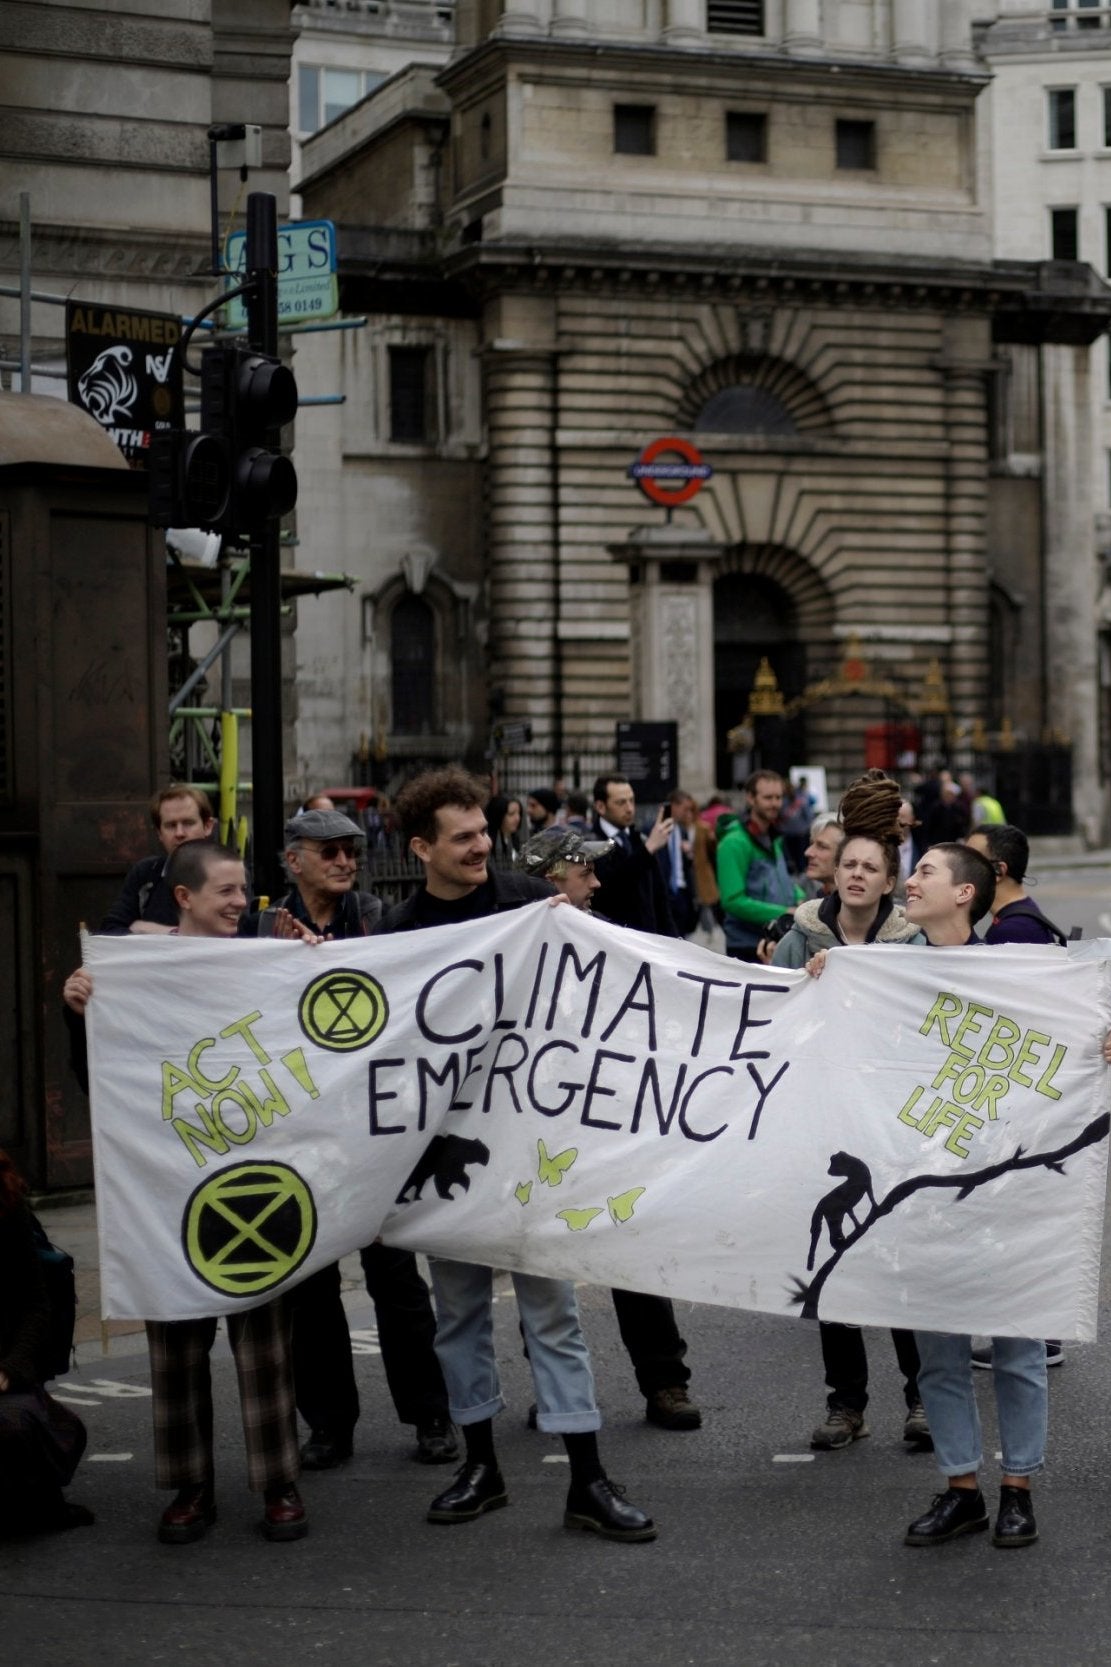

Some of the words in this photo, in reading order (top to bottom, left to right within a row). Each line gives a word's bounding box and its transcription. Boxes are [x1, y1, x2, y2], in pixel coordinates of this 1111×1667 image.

[69, 304, 180, 345] ALARMED
[414, 941, 791, 1061] CLIMATE
[918, 991, 1068, 1101] REBEL
[160, 1010, 272, 1121] ACT
[171, 1046, 321, 1168] NOW!
[368, 1032, 790, 1142] EMERGENCY
[930, 1051, 1010, 1121] FOR
[897, 1084, 985, 1160] LIFE
